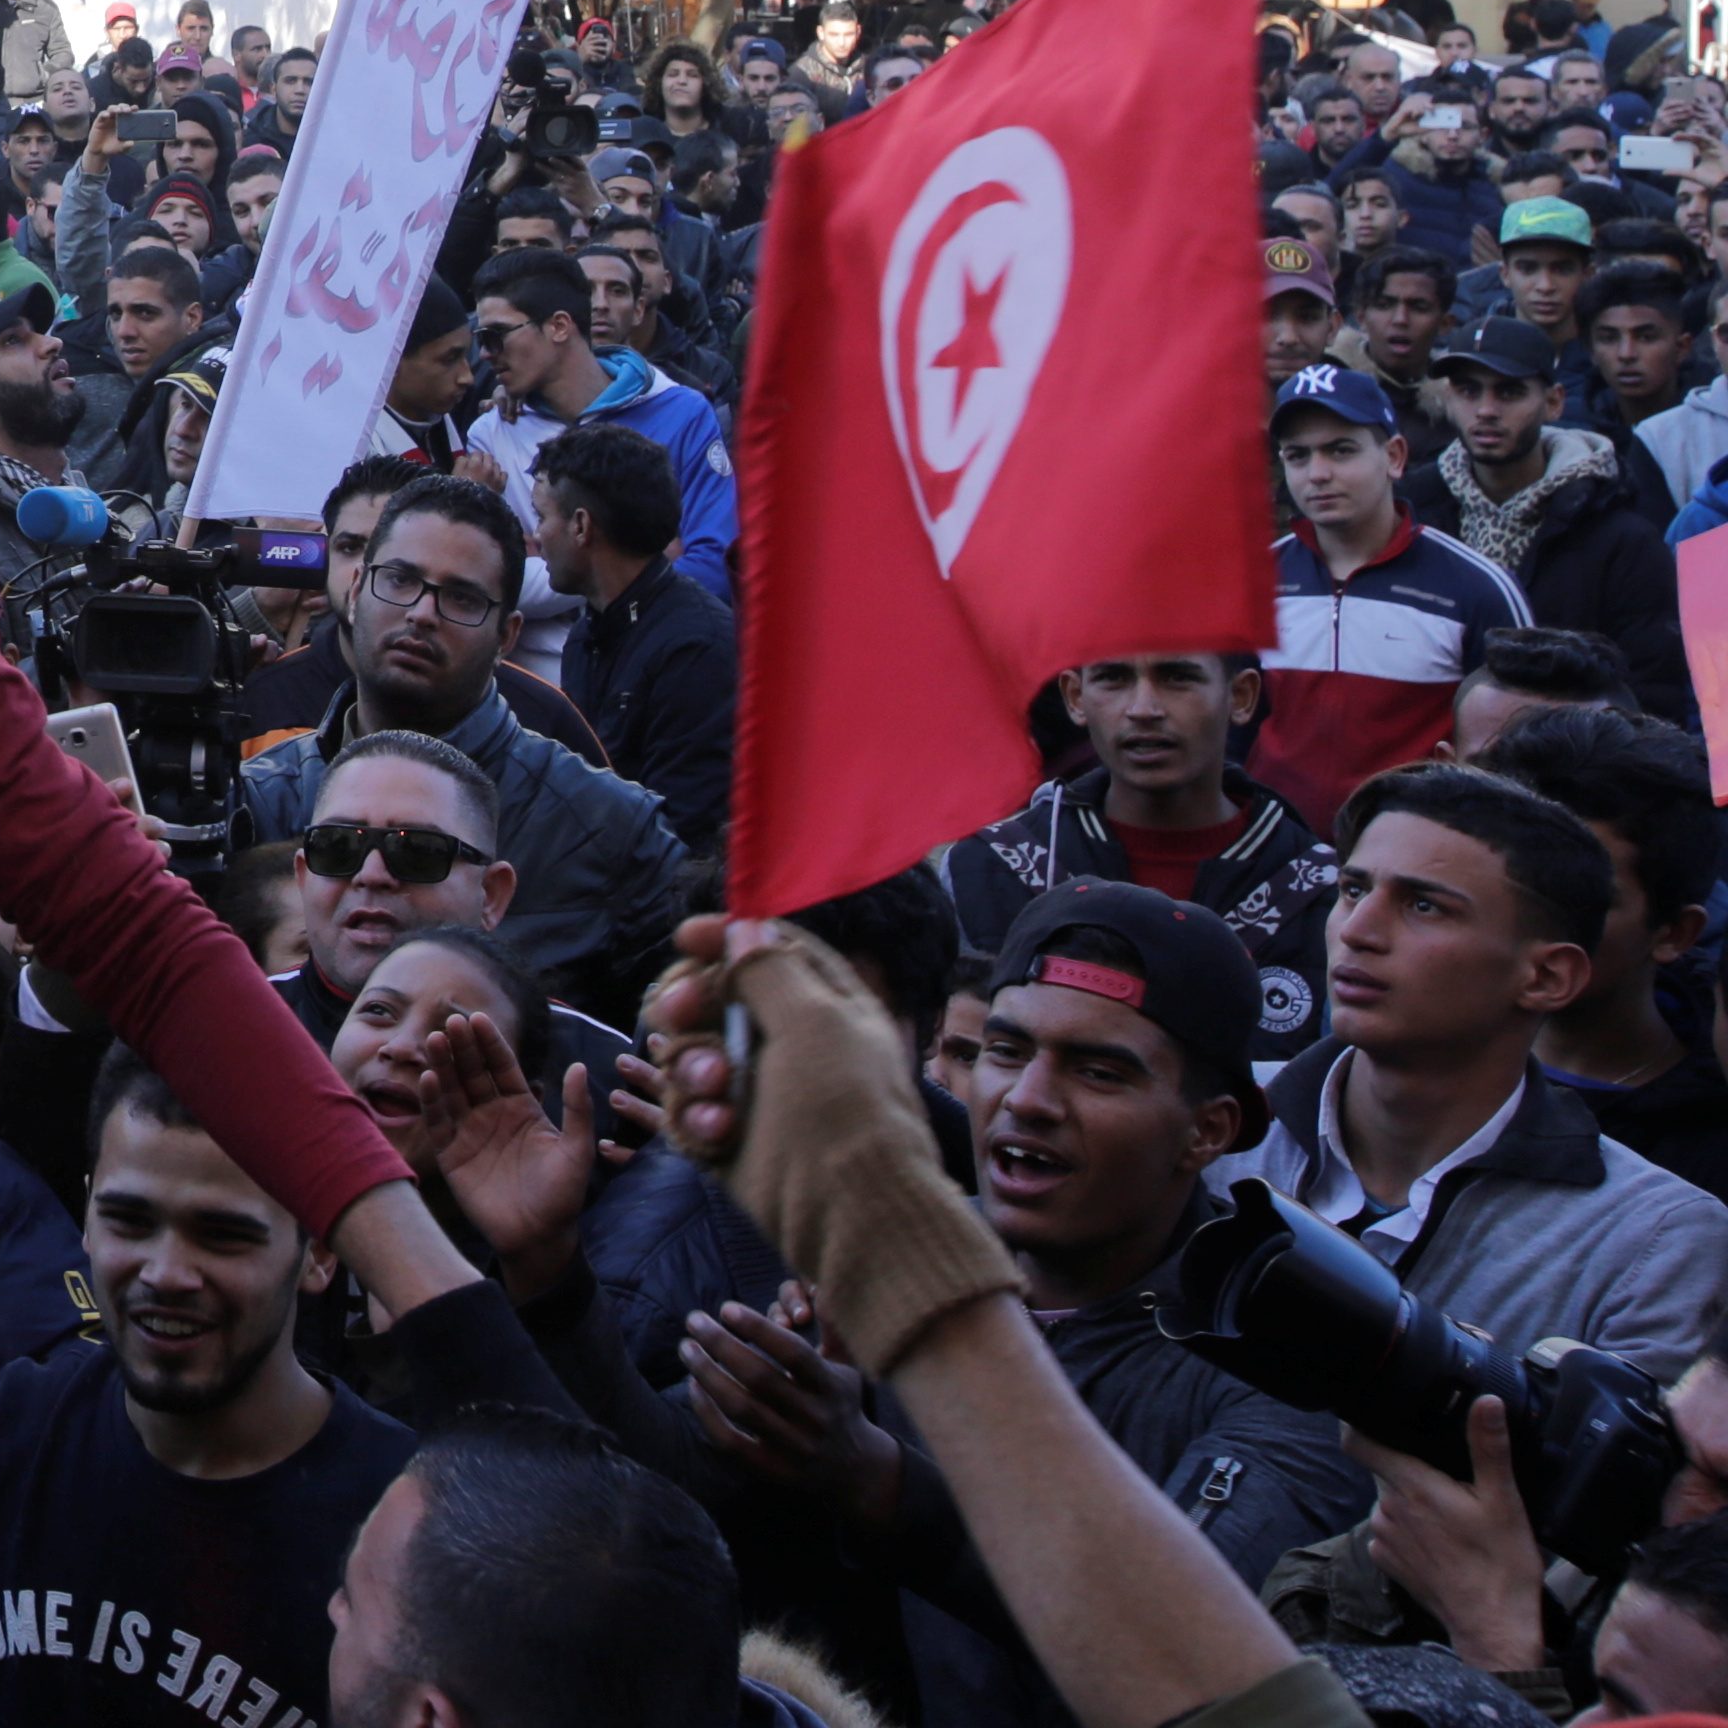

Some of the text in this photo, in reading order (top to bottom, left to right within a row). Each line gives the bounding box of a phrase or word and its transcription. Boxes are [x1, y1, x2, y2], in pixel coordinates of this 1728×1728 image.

[1294, 363, 1338, 395] NY
[266, 546, 301, 561] AFP
[87, 1599, 152, 1674] IS
